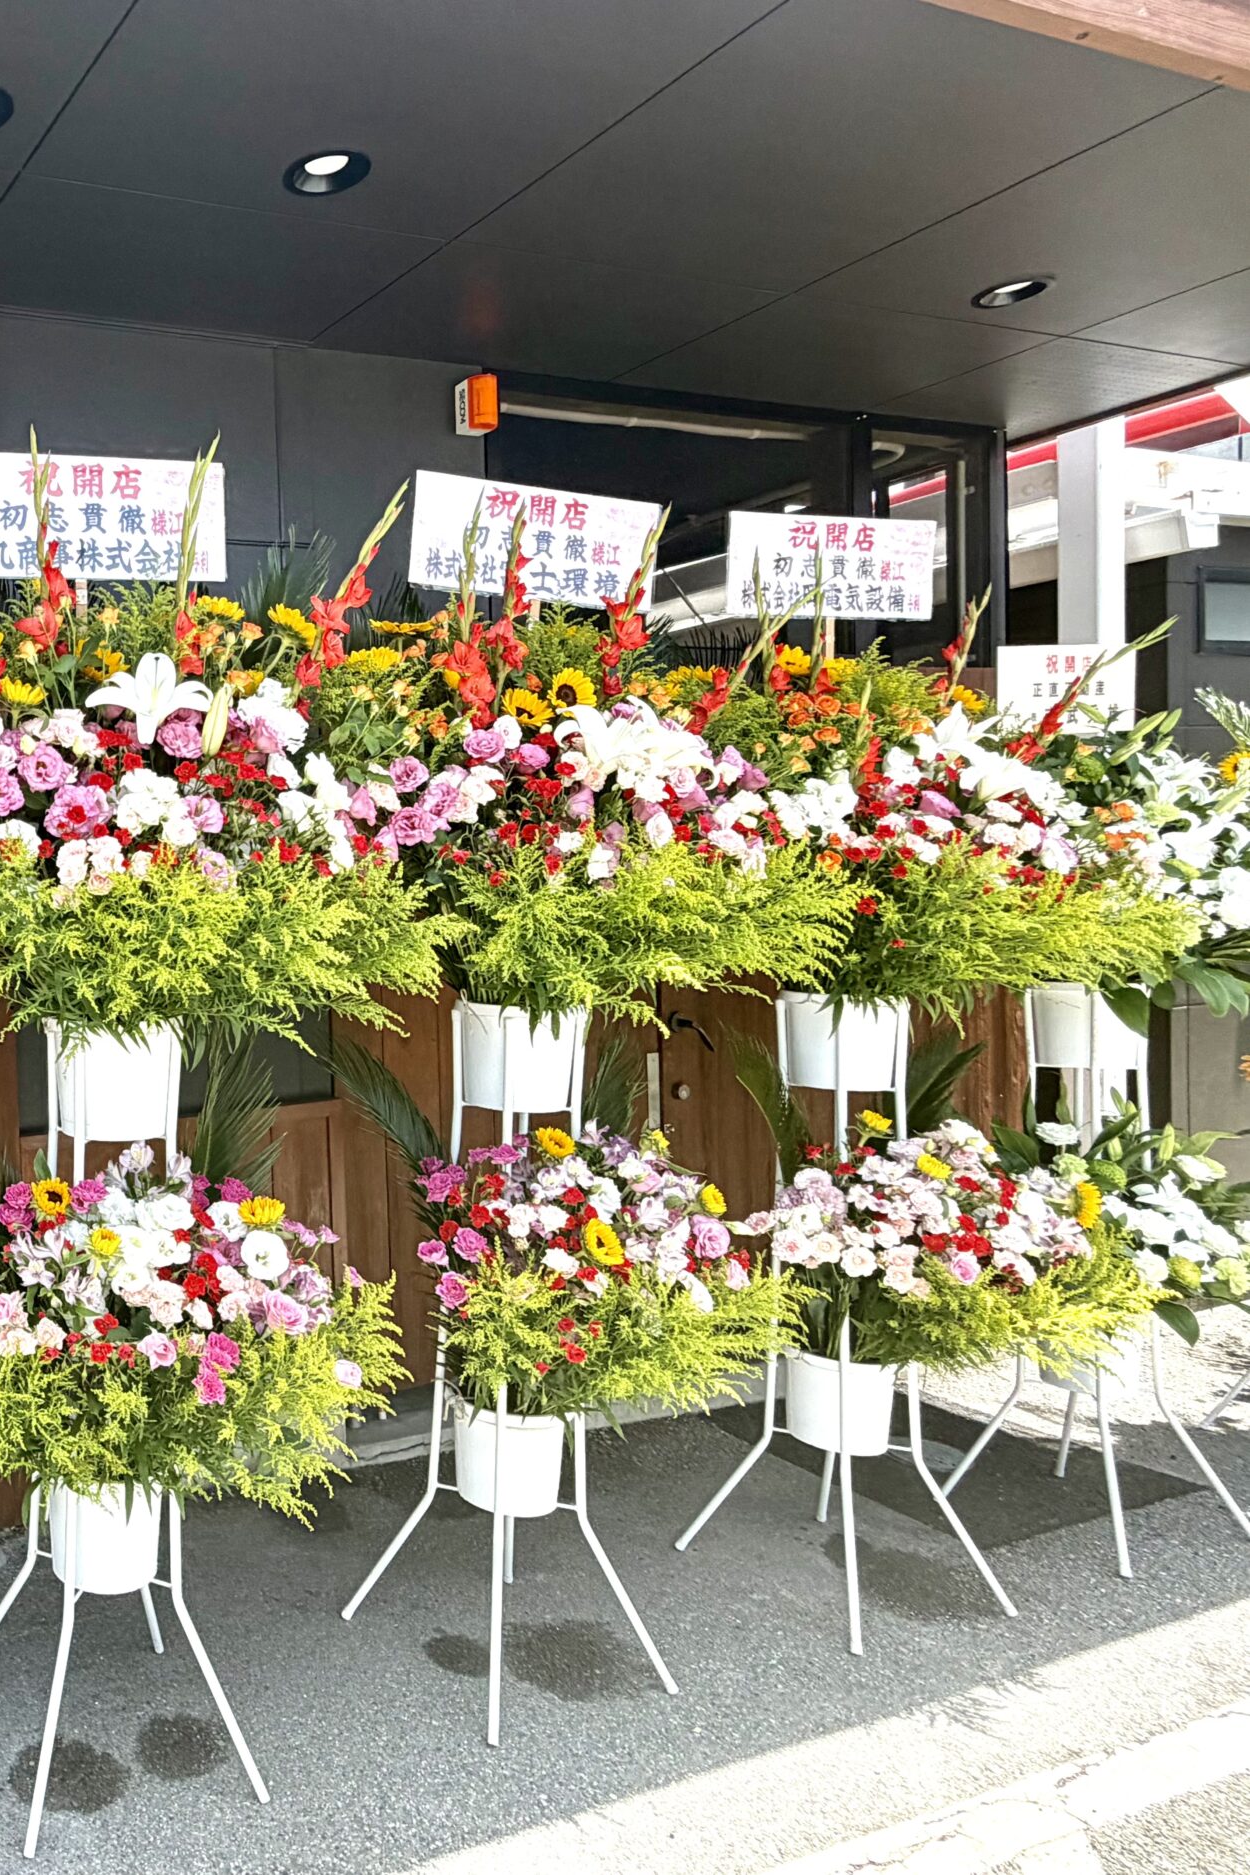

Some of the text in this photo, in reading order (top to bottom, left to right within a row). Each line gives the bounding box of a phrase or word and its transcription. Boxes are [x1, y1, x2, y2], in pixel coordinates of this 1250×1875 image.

[18, 460, 143, 500] 祝開店
[485, 486, 589, 531] 祝開店
[788, 520, 876, 552] 祝開店
